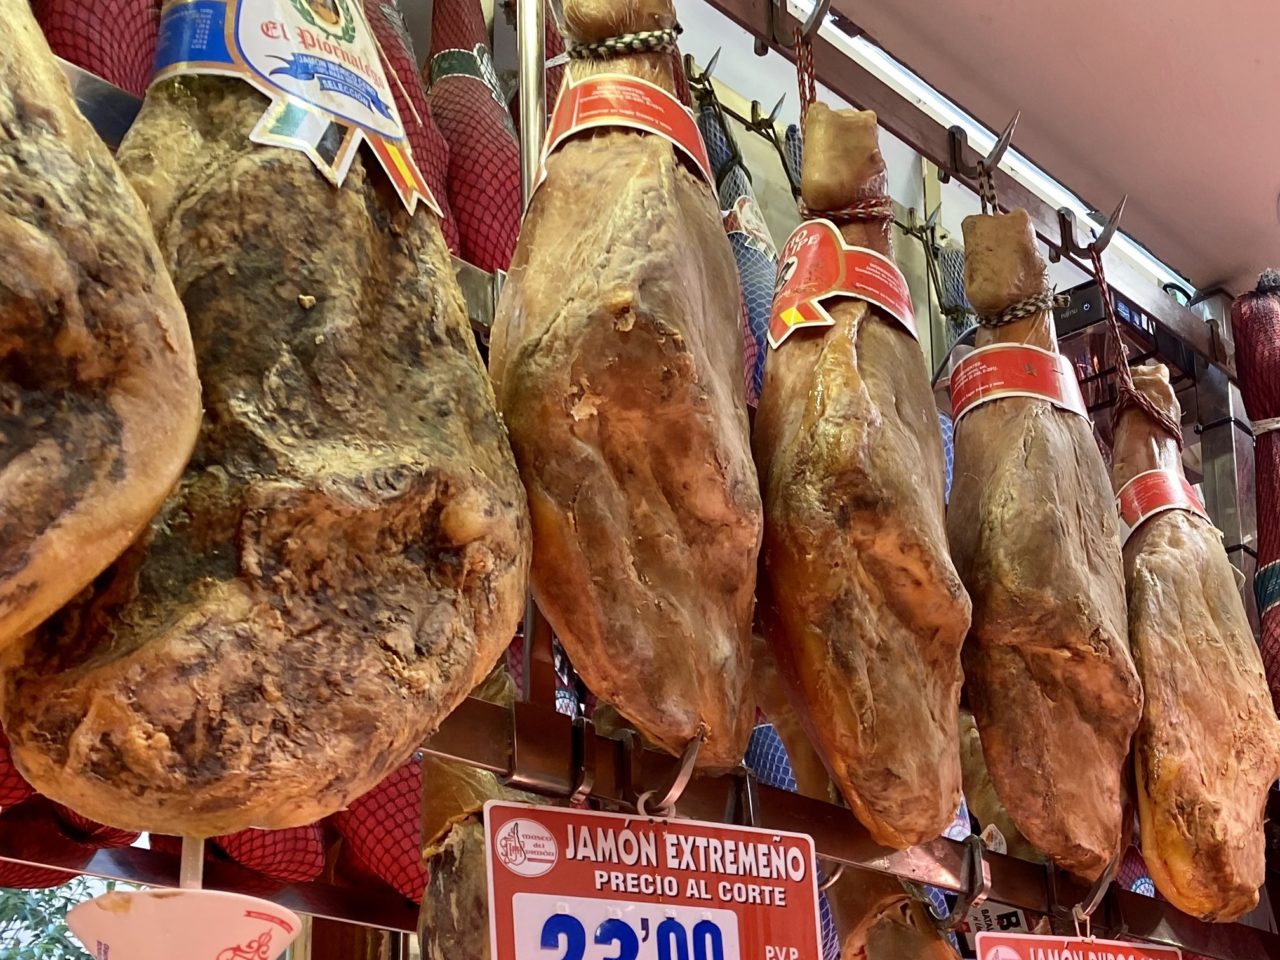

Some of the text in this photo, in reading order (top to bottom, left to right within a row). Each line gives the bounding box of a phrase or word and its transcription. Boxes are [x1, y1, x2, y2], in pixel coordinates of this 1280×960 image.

[260, 20, 290, 41] El
[565, 818, 806, 883] JAMÓN EXTREMEÑO
[594, 870, 786, 906] PRECIO AL CORTE
